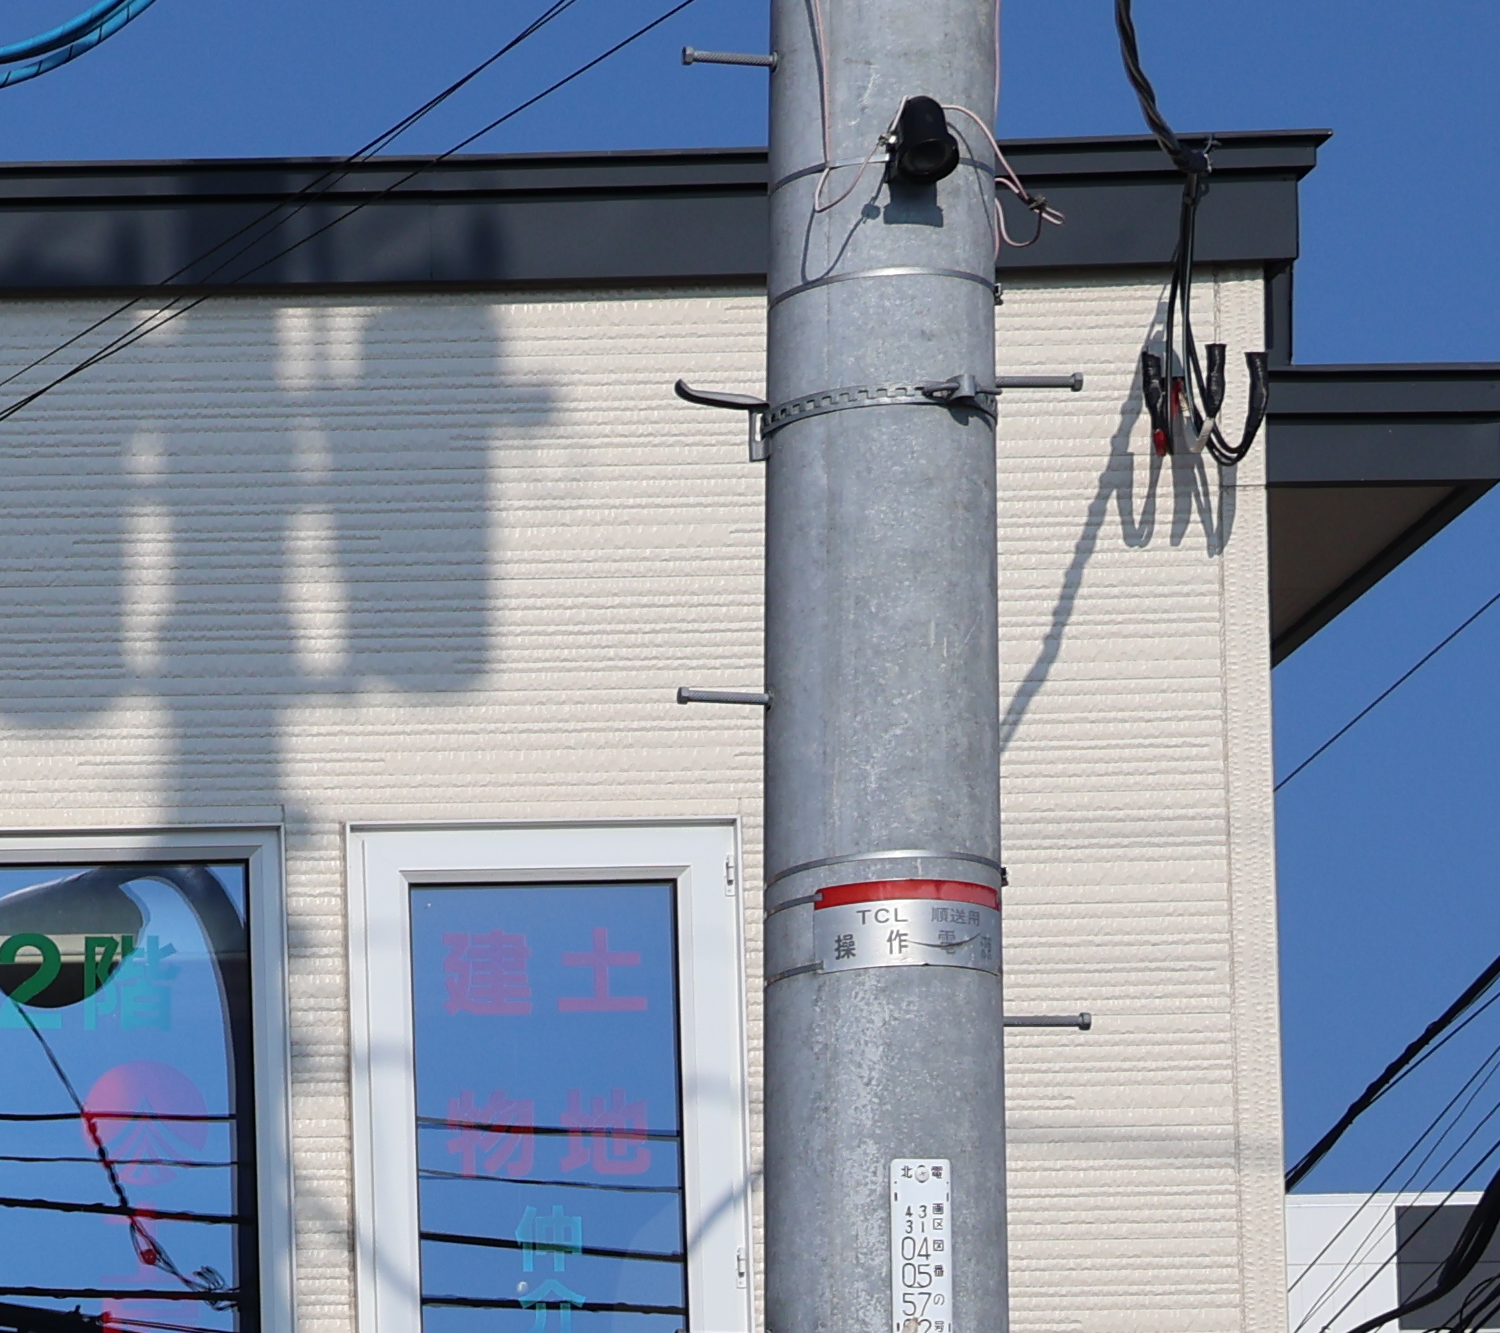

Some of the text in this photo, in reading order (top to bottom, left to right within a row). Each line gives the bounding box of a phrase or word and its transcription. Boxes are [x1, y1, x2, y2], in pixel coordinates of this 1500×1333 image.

[856, 908, 909, 925] TCL
[442, 929, 535, 1180] 建物
[557, 929, 650, 1177] 土地
